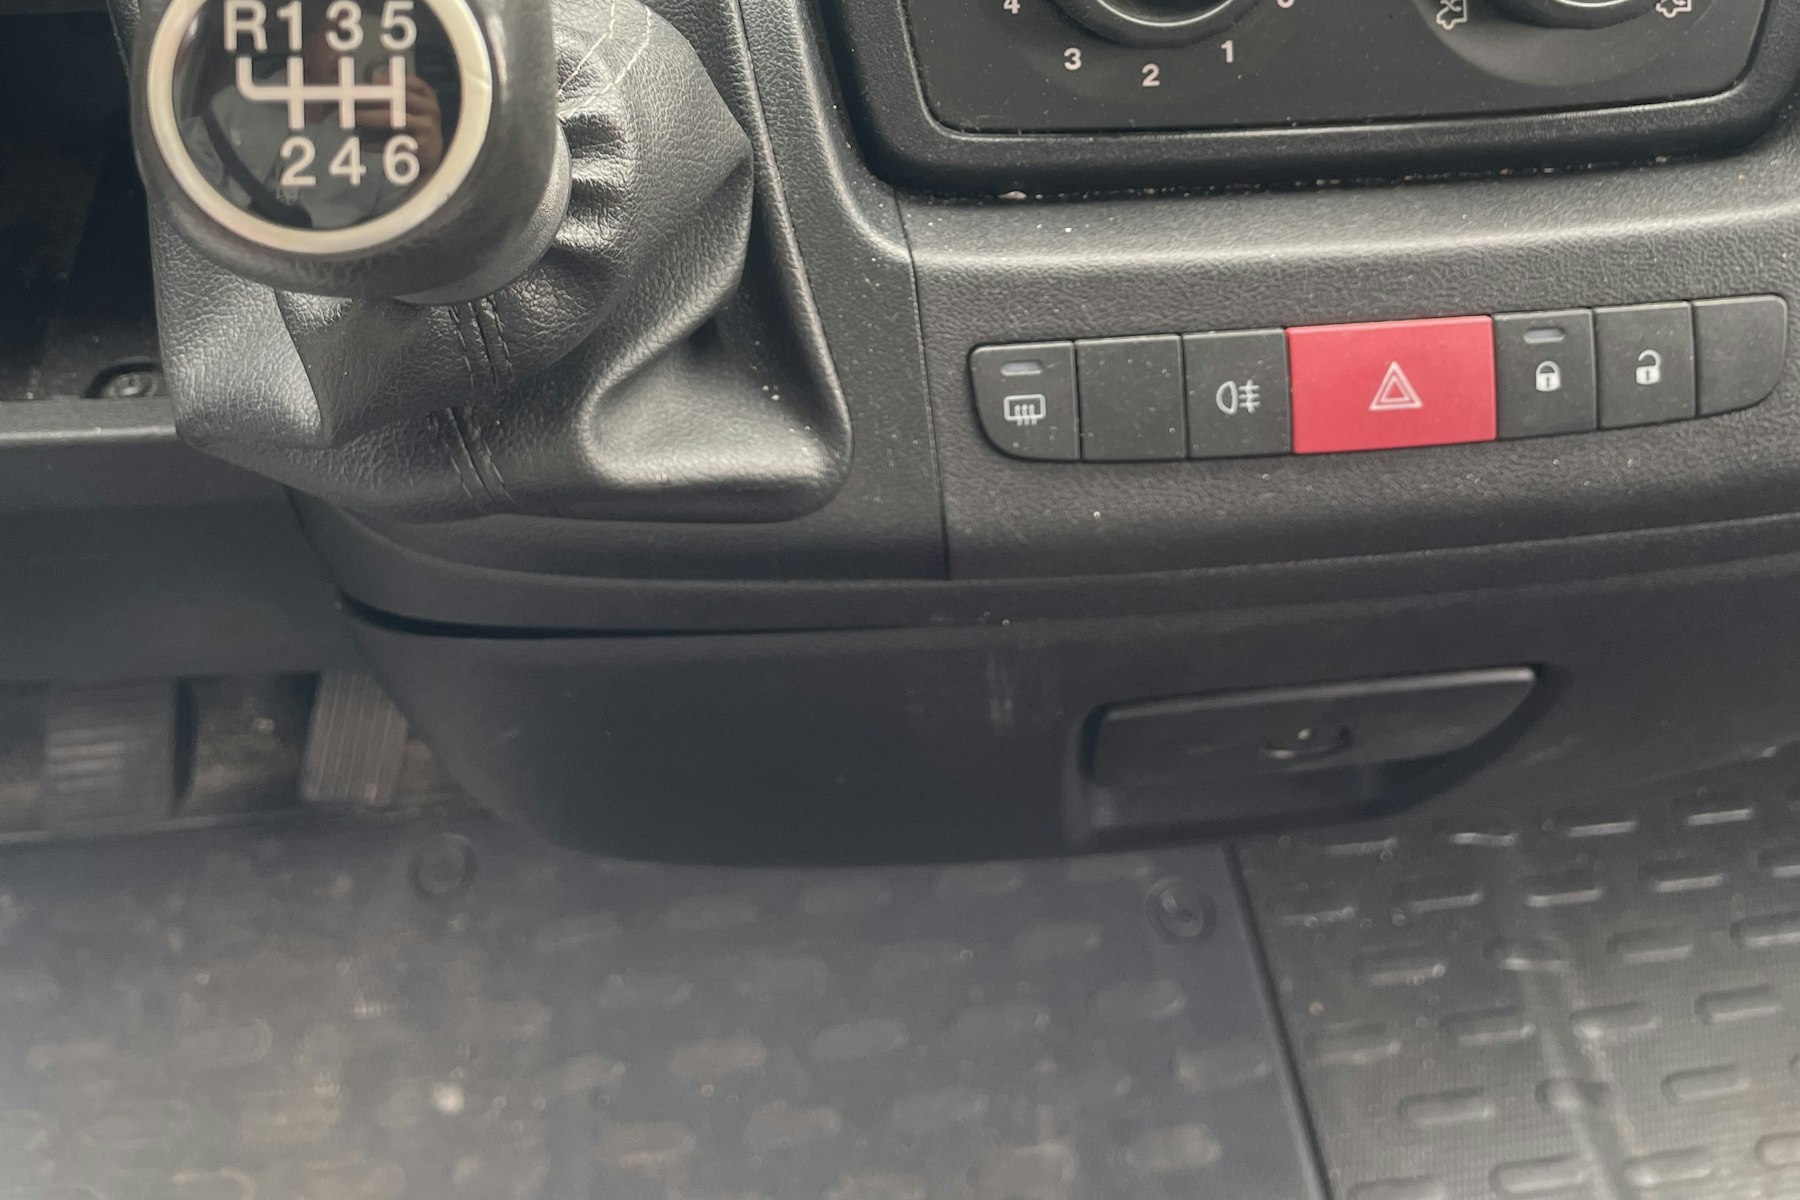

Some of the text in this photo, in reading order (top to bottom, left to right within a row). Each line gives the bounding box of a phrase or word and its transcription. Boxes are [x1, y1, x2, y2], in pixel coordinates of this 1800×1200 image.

[276, 0, 303, 51] 1
[324, 0, 364, 51] 3
[379, 0, 417, 51] 5
[1063, 47, 1082, 71] 3
[1220, 39, 1234, 63] 1
[1141, 63, 1161, 87] 2
[279, 134, 421, 187] 2 4 6
